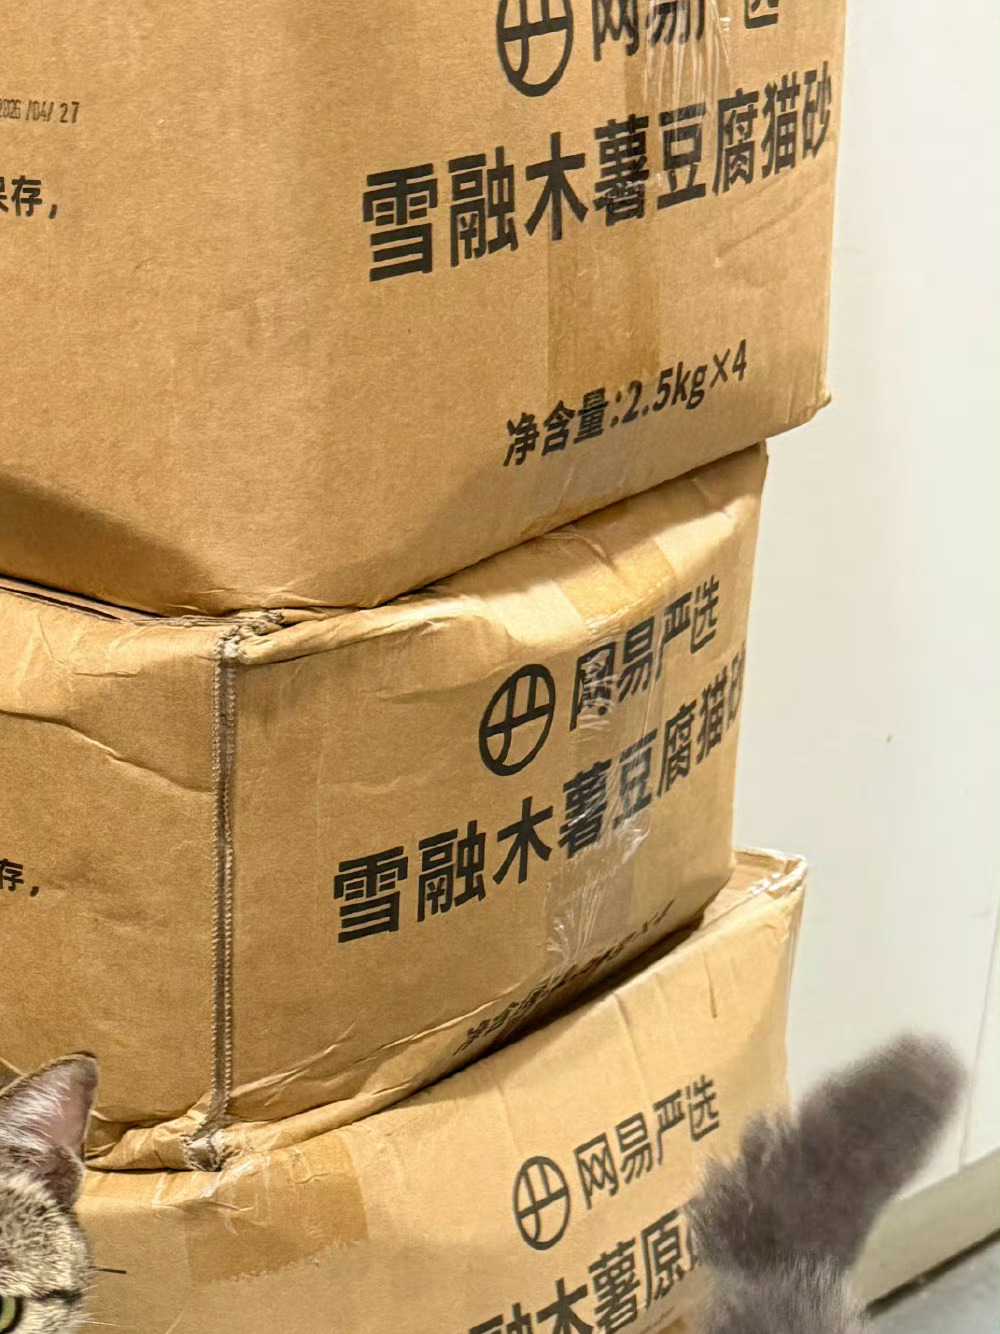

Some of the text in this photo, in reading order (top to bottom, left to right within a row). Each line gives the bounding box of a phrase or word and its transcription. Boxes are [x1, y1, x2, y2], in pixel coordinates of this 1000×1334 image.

[362, 61, 832, 283] 雪融木薯豆腐猫砂
[569, 574, 720, 732] 网易严选
[573, 1073, 720, 1211] 网易严选
